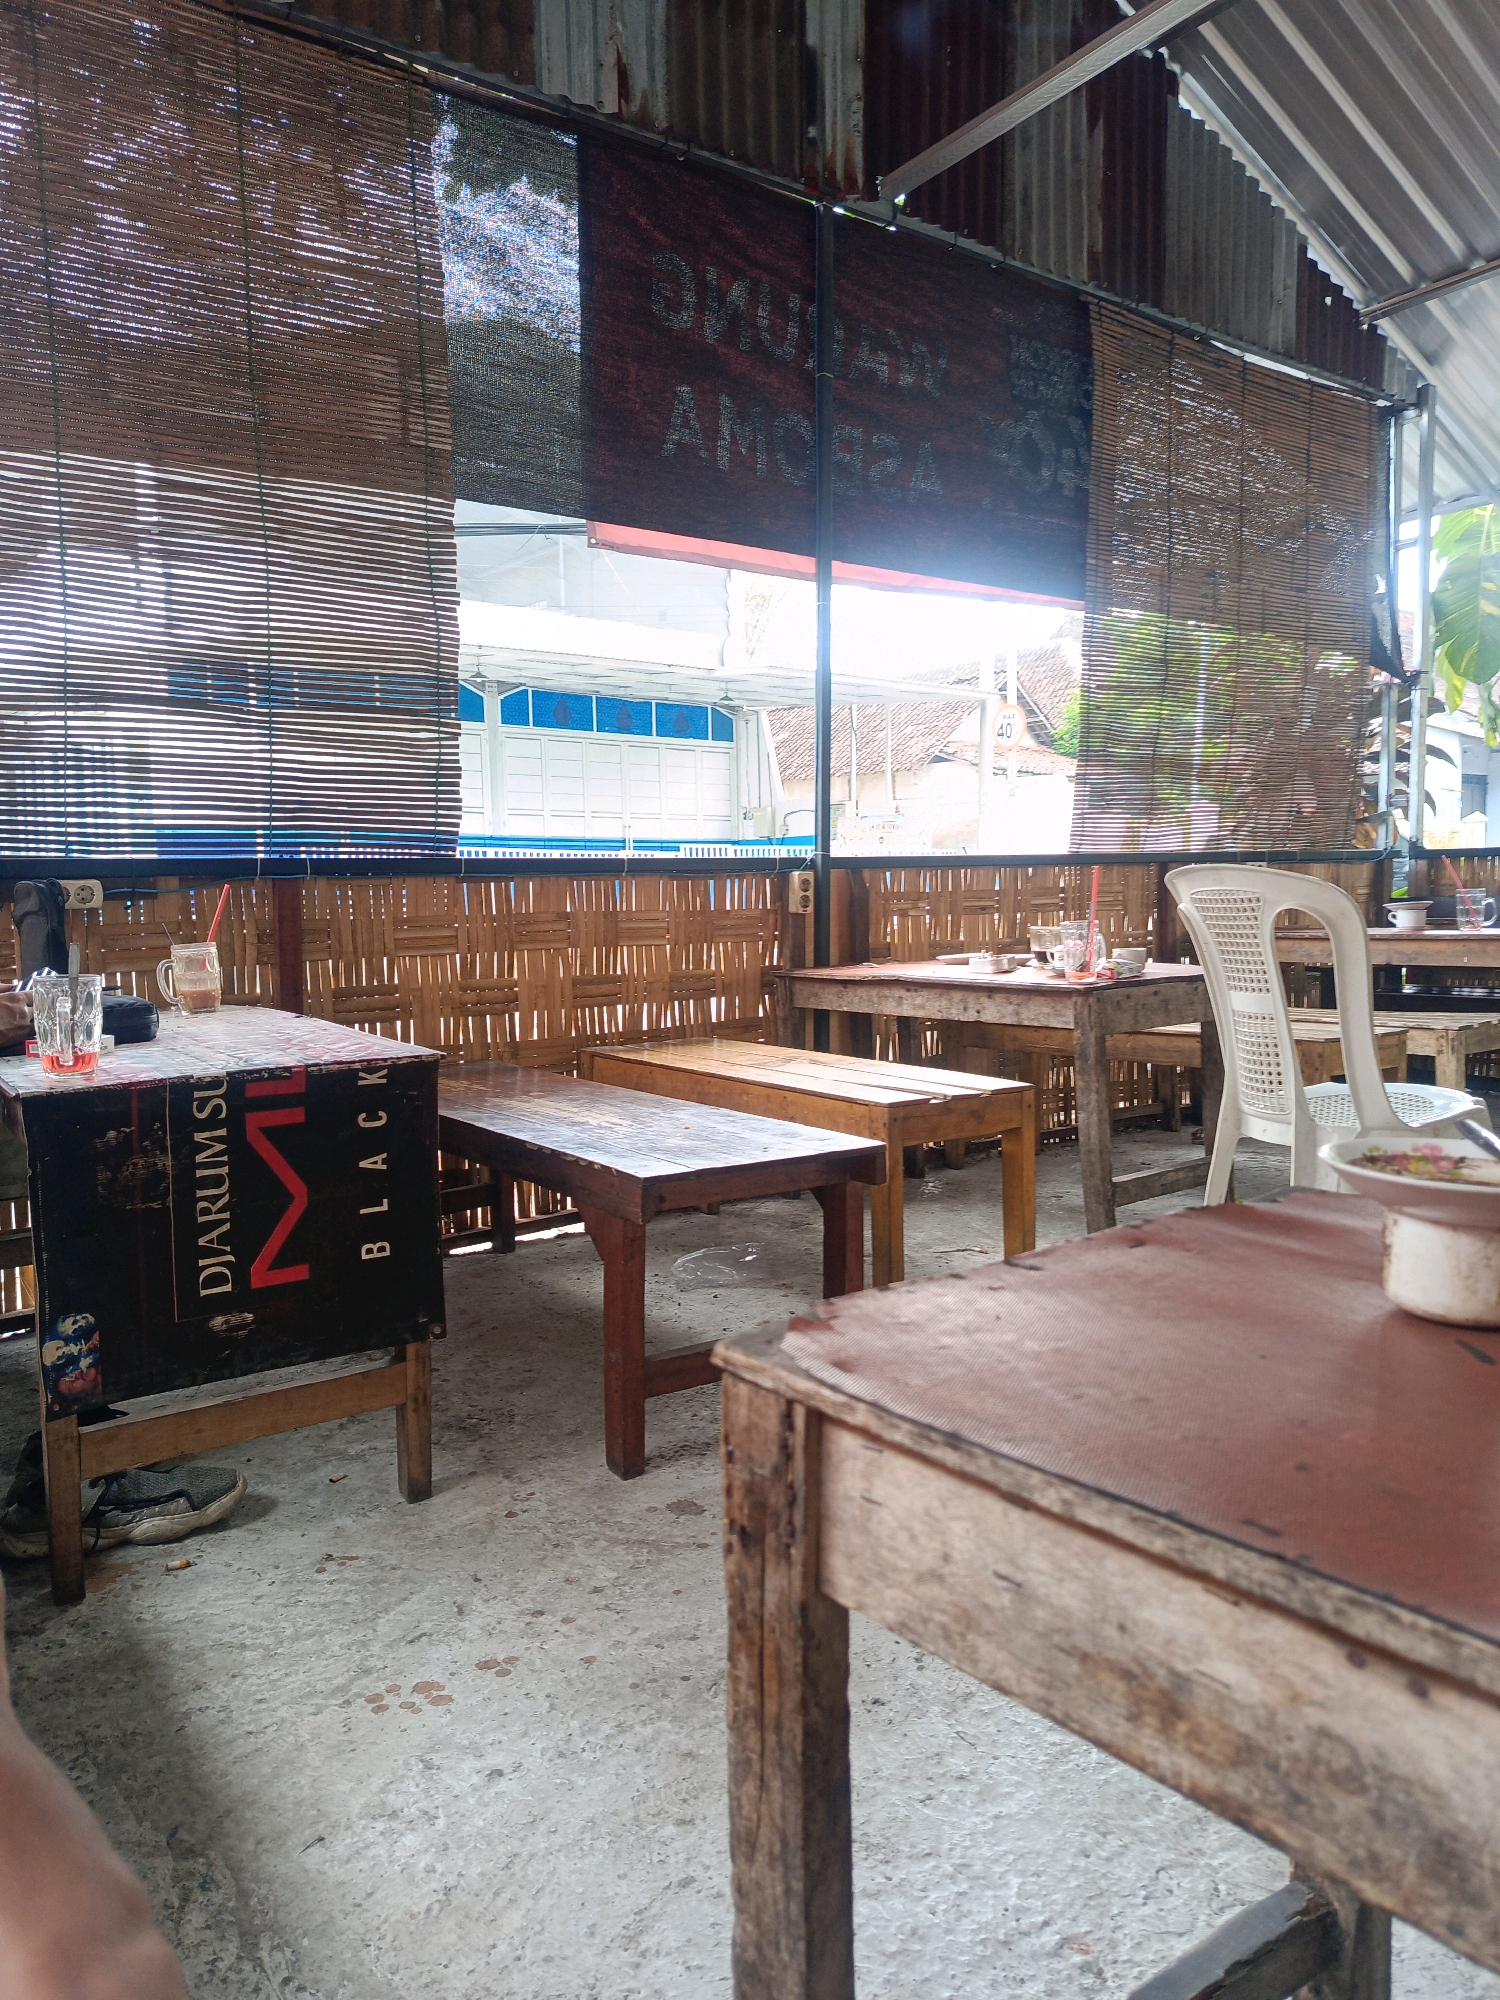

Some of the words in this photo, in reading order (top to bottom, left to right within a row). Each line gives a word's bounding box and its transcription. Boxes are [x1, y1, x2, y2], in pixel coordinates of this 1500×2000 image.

[996, 722, 1013, 739] 40
[193, 1127, 235, 1297] DJARUM
[357, 1068, 391, 1260] BLACK
